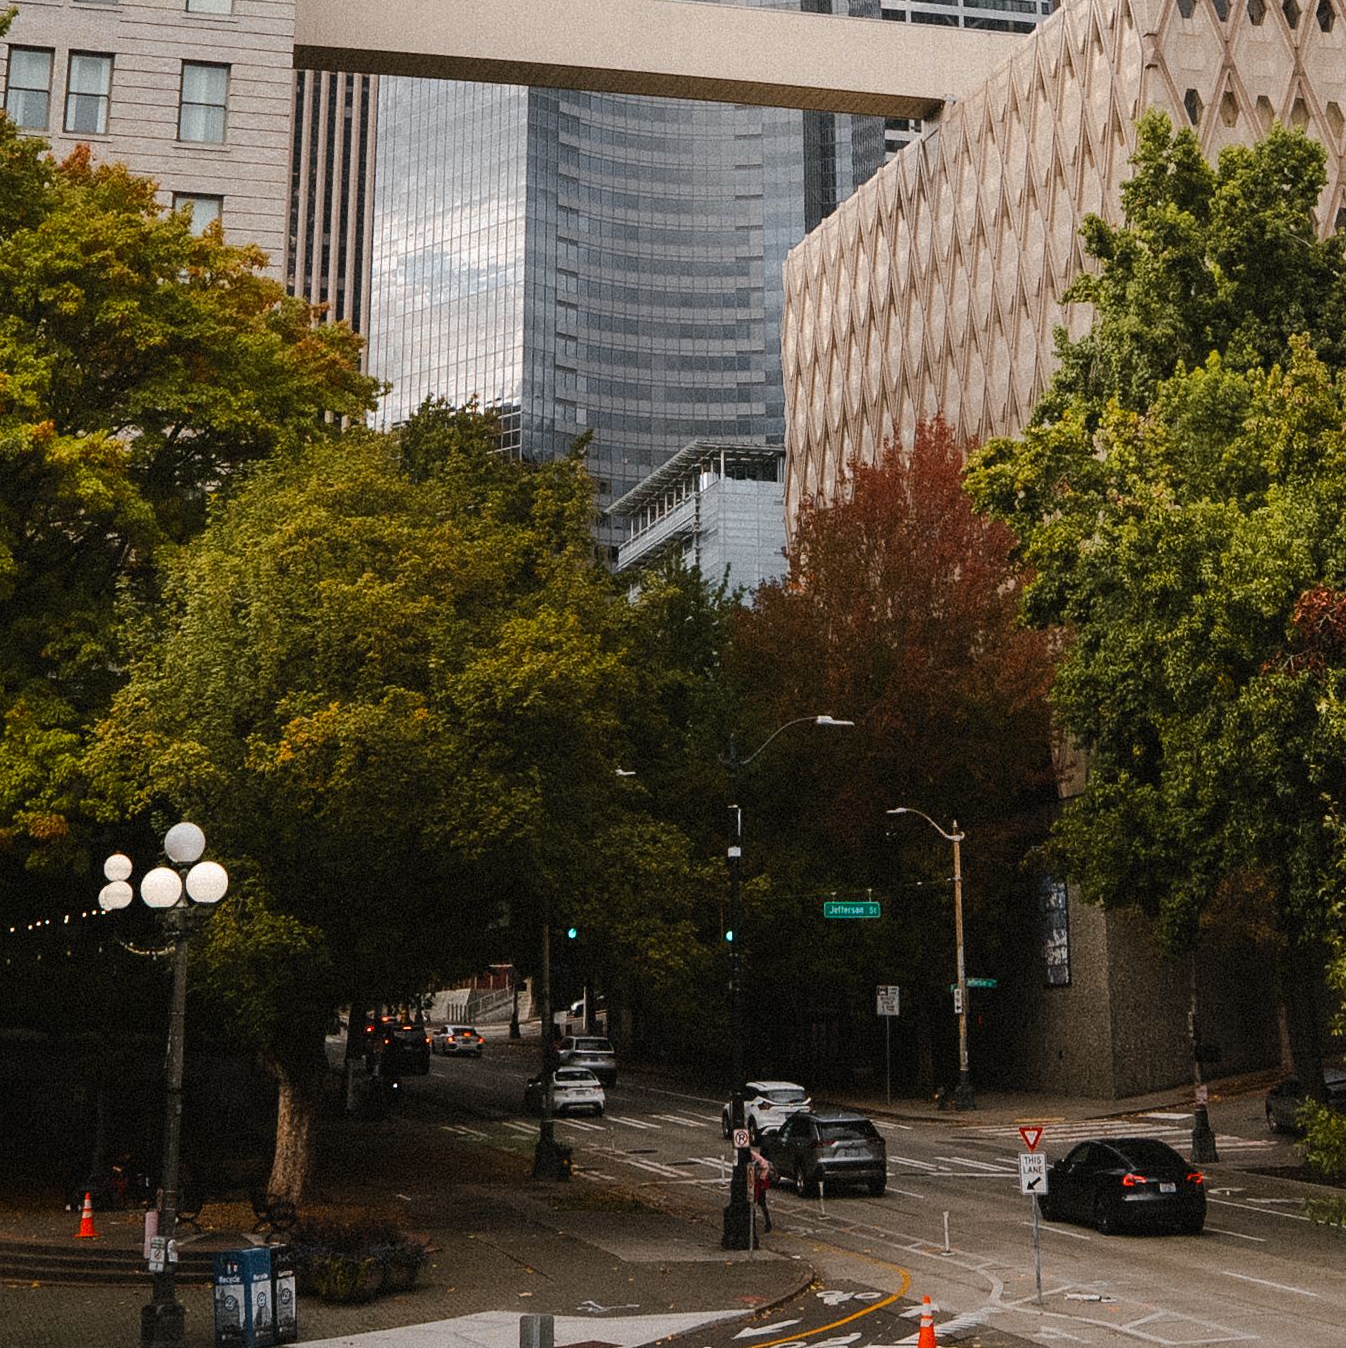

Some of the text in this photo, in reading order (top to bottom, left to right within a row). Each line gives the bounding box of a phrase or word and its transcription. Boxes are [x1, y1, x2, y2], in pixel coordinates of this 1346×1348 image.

[829, 905, 877, 914] Jefferson St
[1024, 1155, 1042, 1165] THIS
[1022, 1165, 1043, 1175] LANE
[219, 1276, 240, 1284] Recycle
